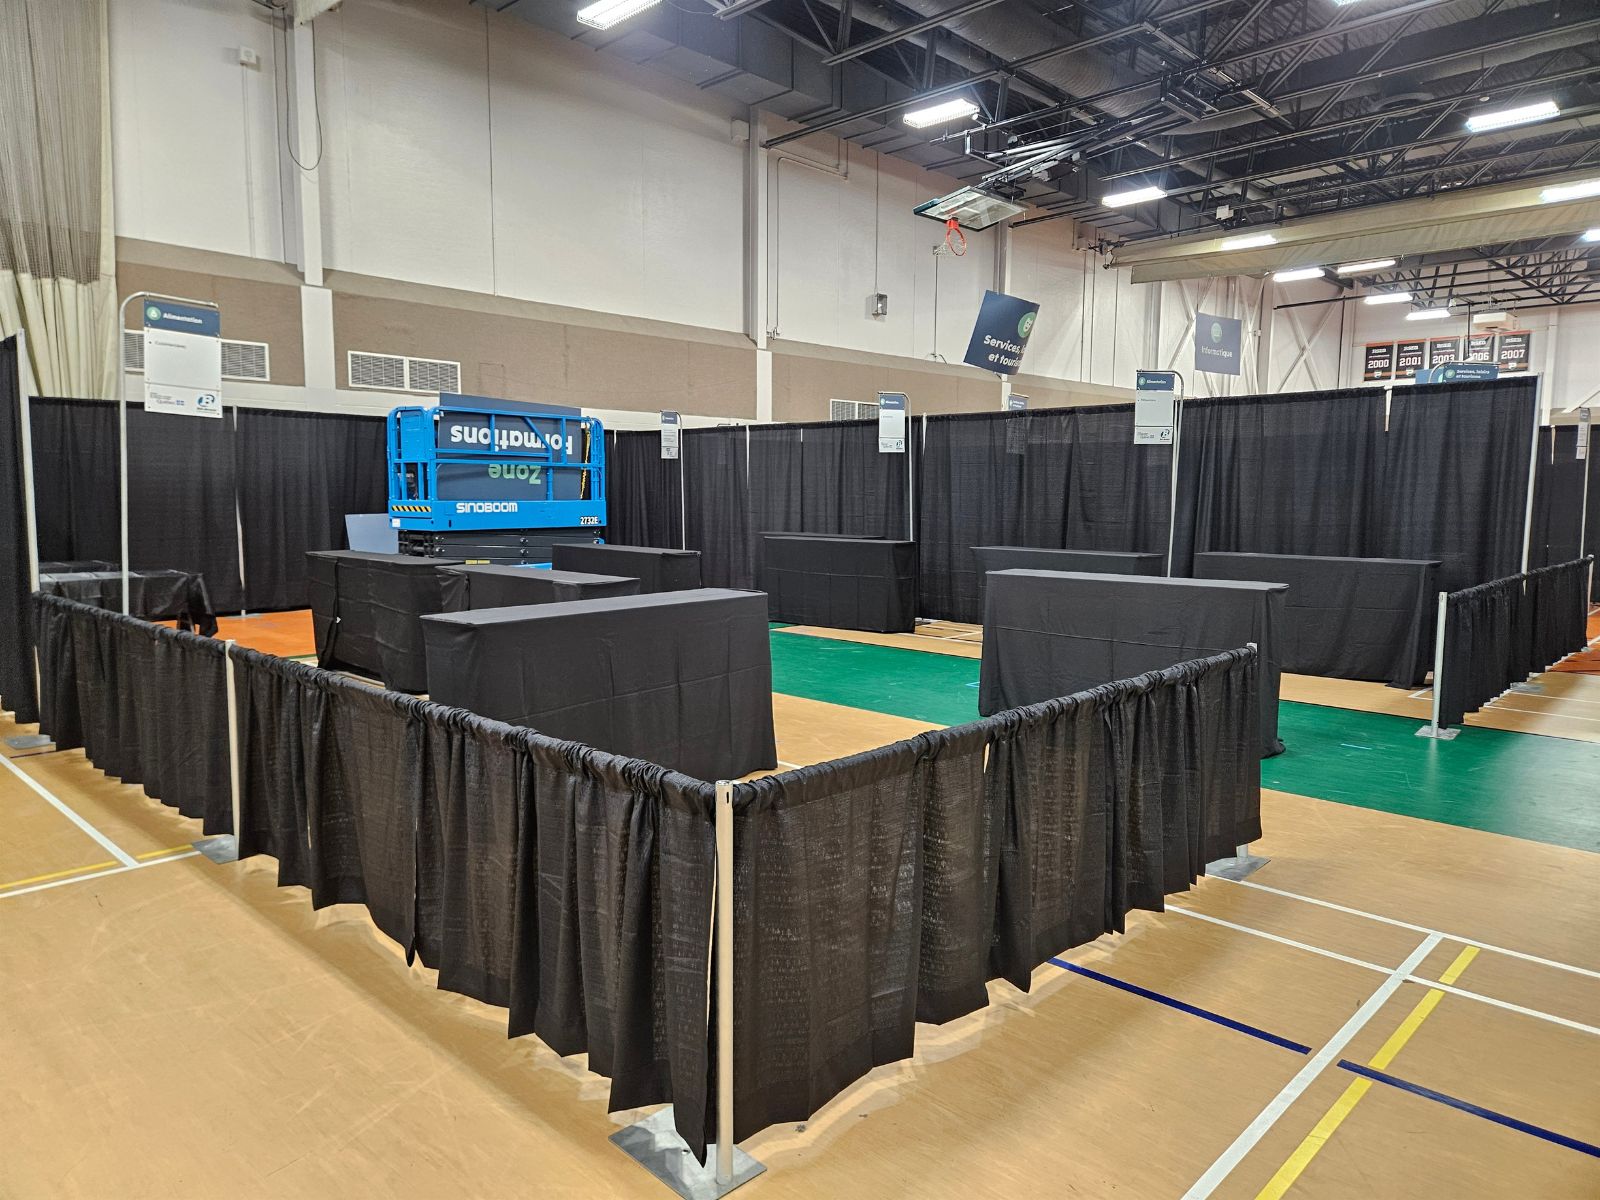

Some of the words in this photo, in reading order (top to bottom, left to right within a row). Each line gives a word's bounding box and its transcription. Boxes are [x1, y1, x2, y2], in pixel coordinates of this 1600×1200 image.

[984, 335, 1020, 354] Services,
[988, 354, 999, 362] et
[1432, 355, 1455, 364] 2003
[1501, 350, 1525, 360] 2007
[1368, 360, 1389, 369] 2000
[1400, 357, 1422, 367] 2001
[488, 464, 541, 485] Zone
[580, 517, 599, 525] 2732E
